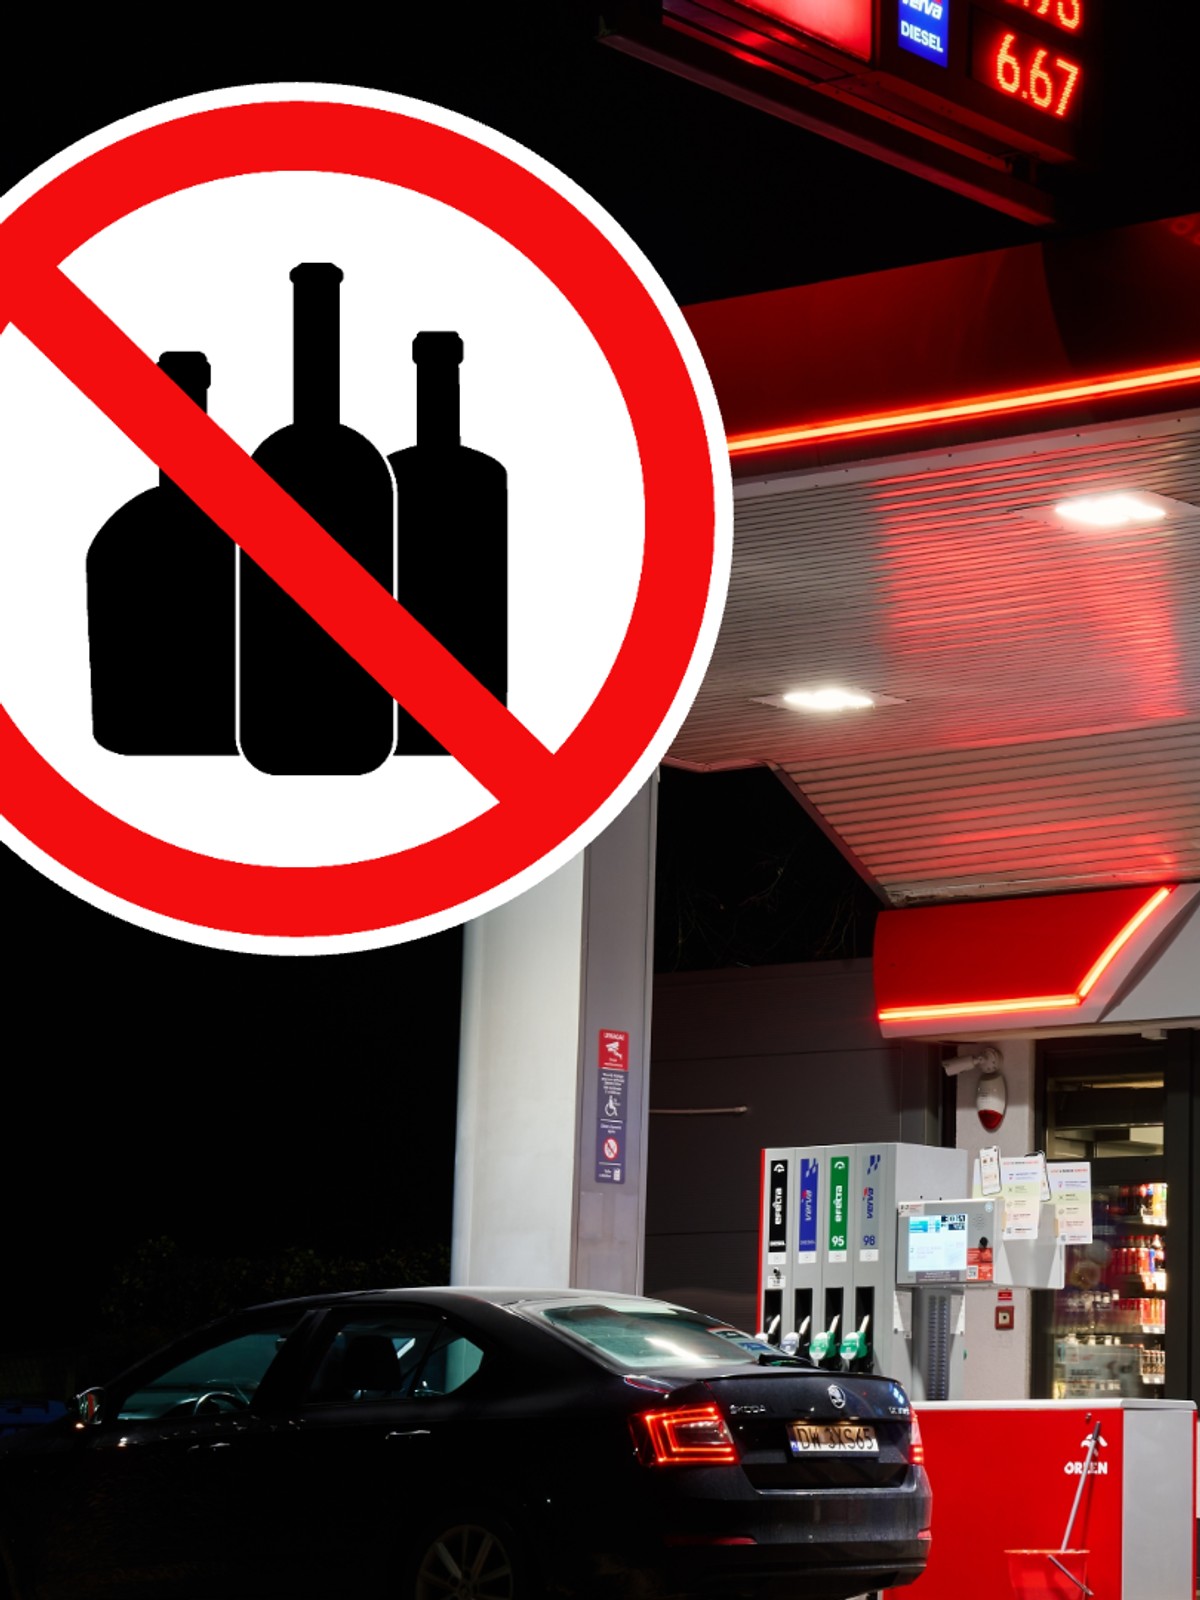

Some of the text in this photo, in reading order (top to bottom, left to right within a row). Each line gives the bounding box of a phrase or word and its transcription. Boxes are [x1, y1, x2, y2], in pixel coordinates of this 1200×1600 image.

[901, 20, 943, 53] DIESEL
[997, 34, 1078, 116] 6.67
[804, 1189, 813, 1221] verva
[866, 1187, 874, 1219] verva
[831, 1236, 845, 1247] 95
[863, 1236, 876, 1245] 98
[796, 1427, 821, 1450] DW
